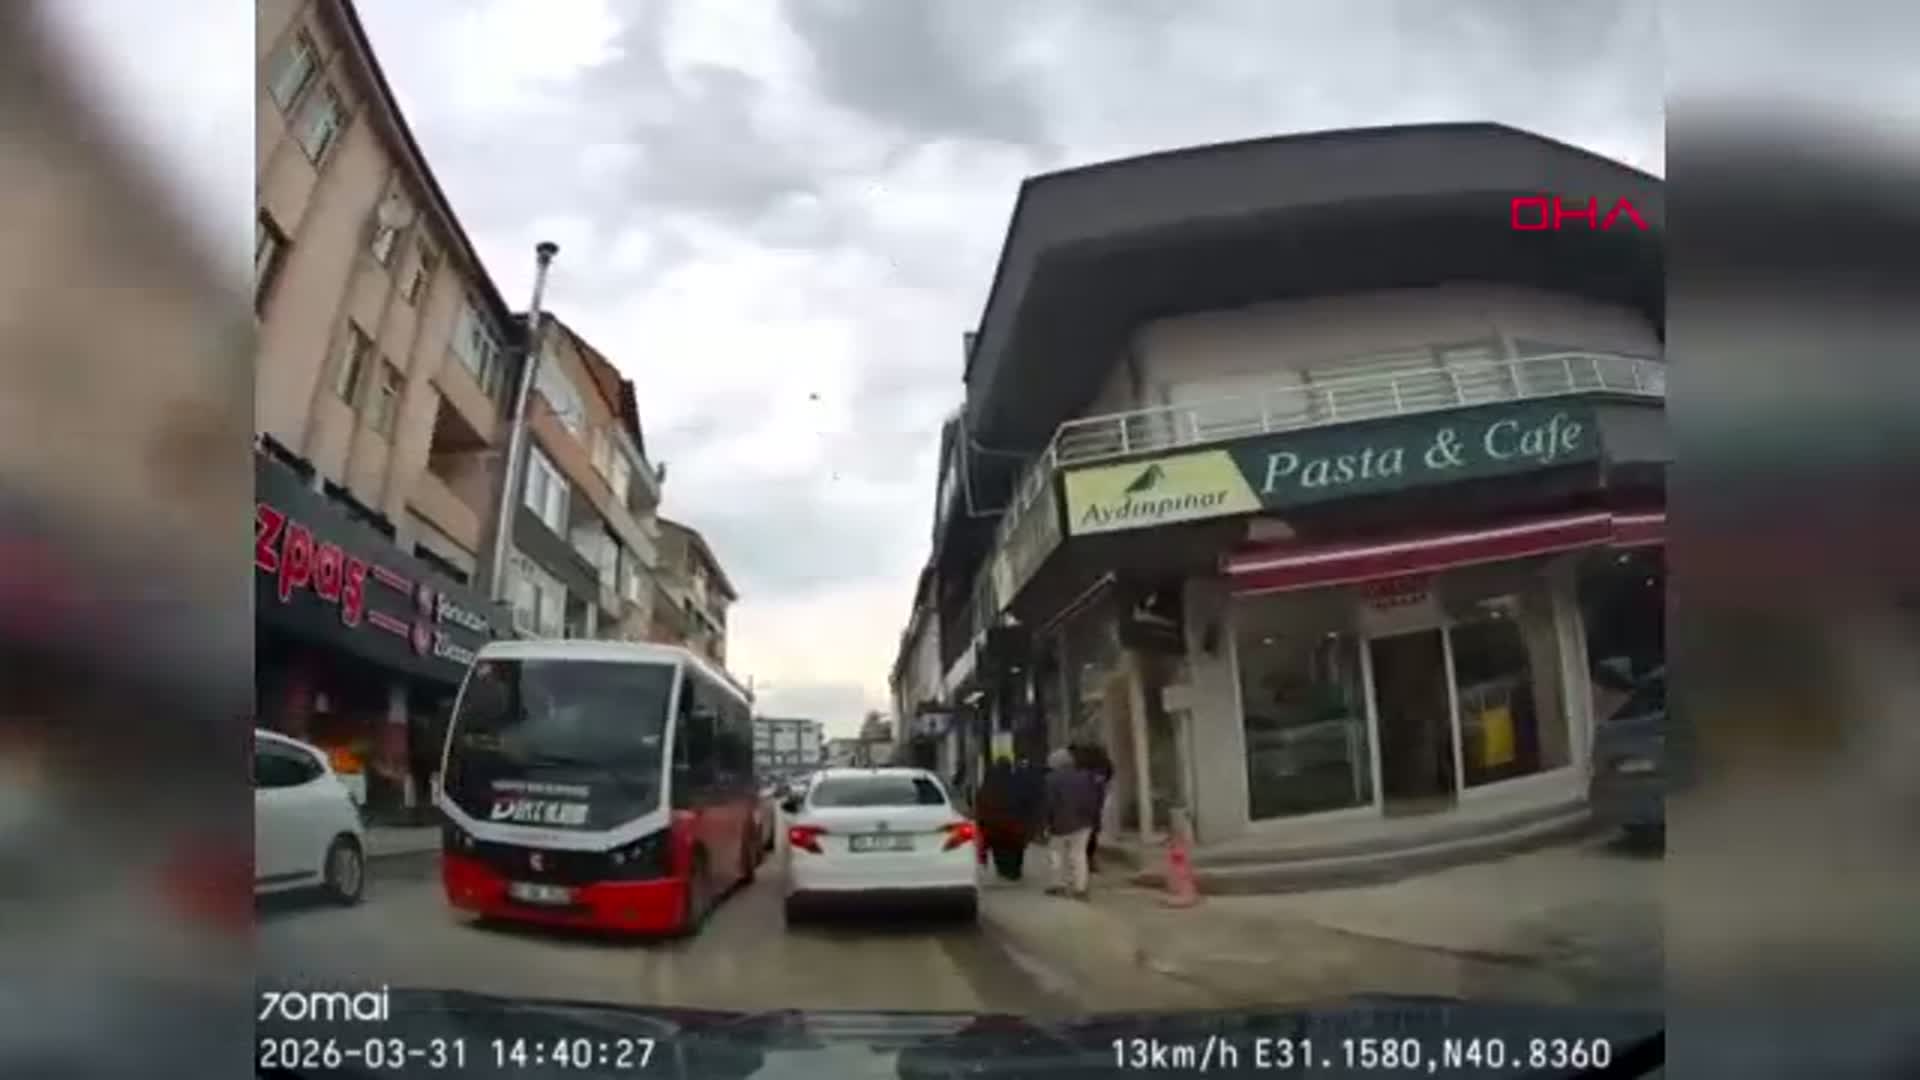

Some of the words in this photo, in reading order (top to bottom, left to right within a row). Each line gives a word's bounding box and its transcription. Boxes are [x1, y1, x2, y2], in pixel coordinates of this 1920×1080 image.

[1262, 447, 1404, 494] Pasta
[1424, 428, 1464, 469] &
[1484, 413, 1583, 464] Cafe
